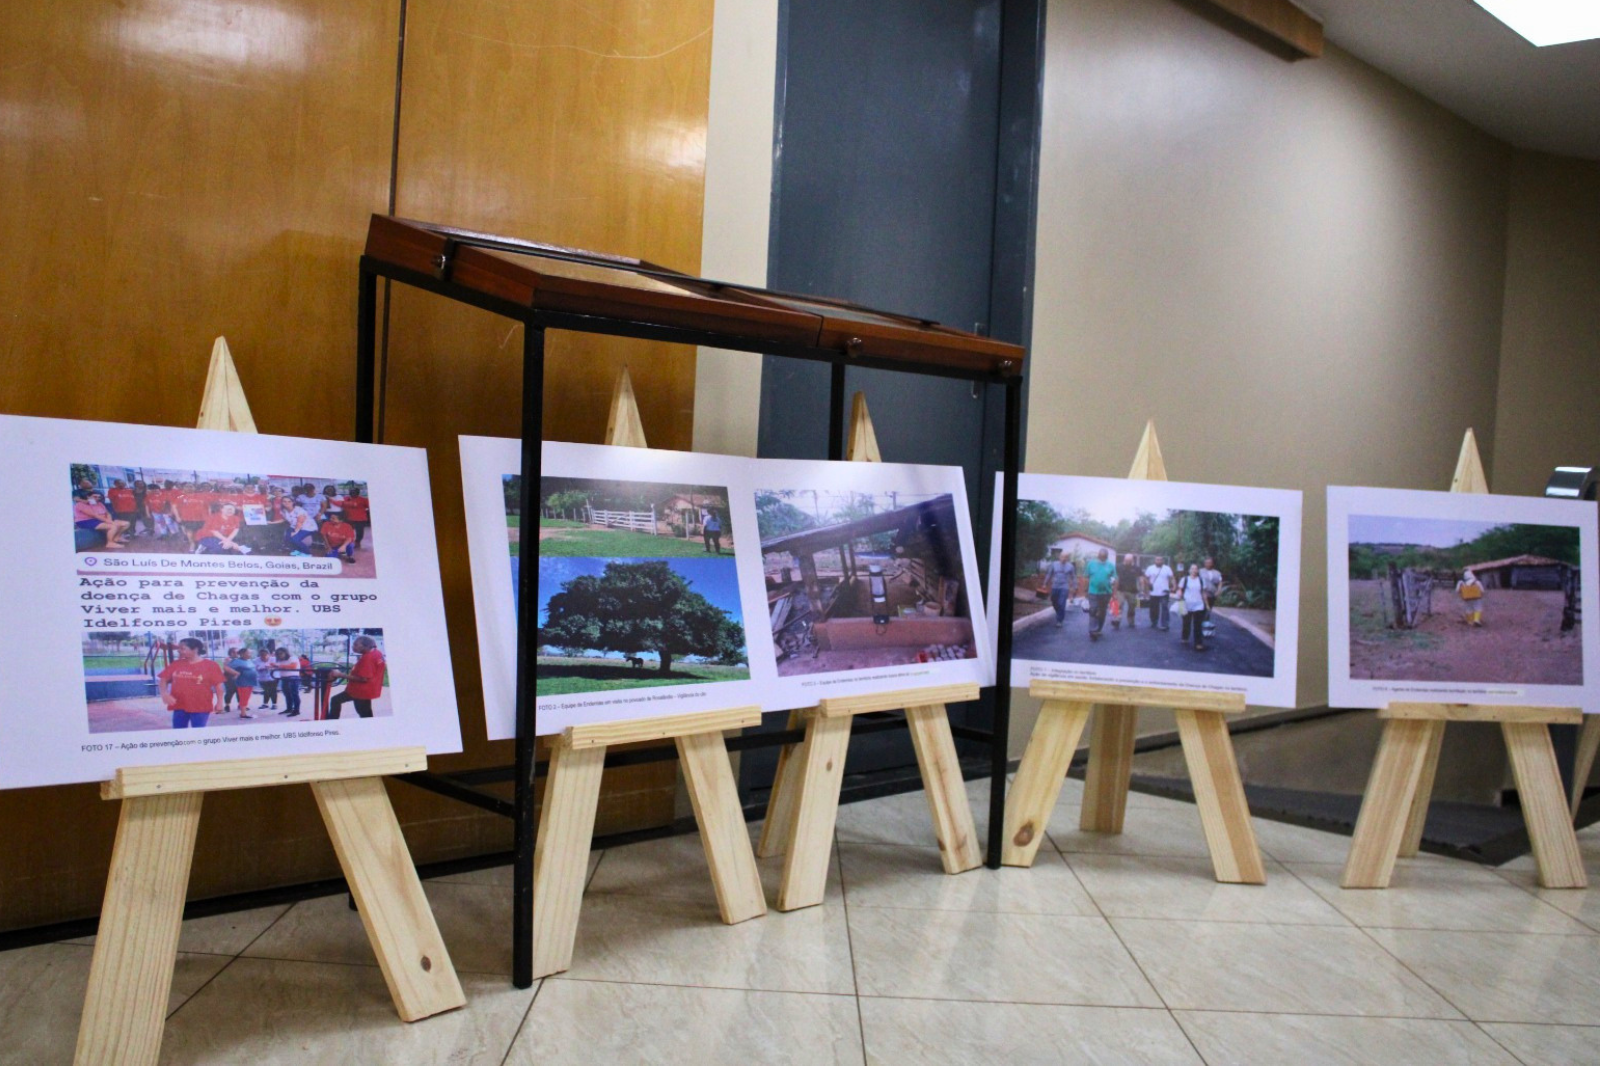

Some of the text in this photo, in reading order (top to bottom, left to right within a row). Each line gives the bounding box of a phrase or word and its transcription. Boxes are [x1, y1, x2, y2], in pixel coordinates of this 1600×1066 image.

[103, 558, 128, 567] São
[132, 558, 158, 567] Luís
[160, 559, 178, 567] De
[180, 560, 225, 568] Montes
[227, 561, 263, 569] Belos,
[302, 562, 333, 570] Brazil
[79, 577, 319, 589] Ação para prevenção da
[80, 591, 151, 602] doença
[163, 591, 185, 600] de
[196, 591, 260, 603] Chagas
[330, 593, 378, 602] grupo
[80, 604, 341, 614] Viver mais e melhor. UBS
[84, 618, 252, 628] Idelfonso Pires
[120, 742, 138, 751] Ação
[203, 737, 221, 745] grupo
